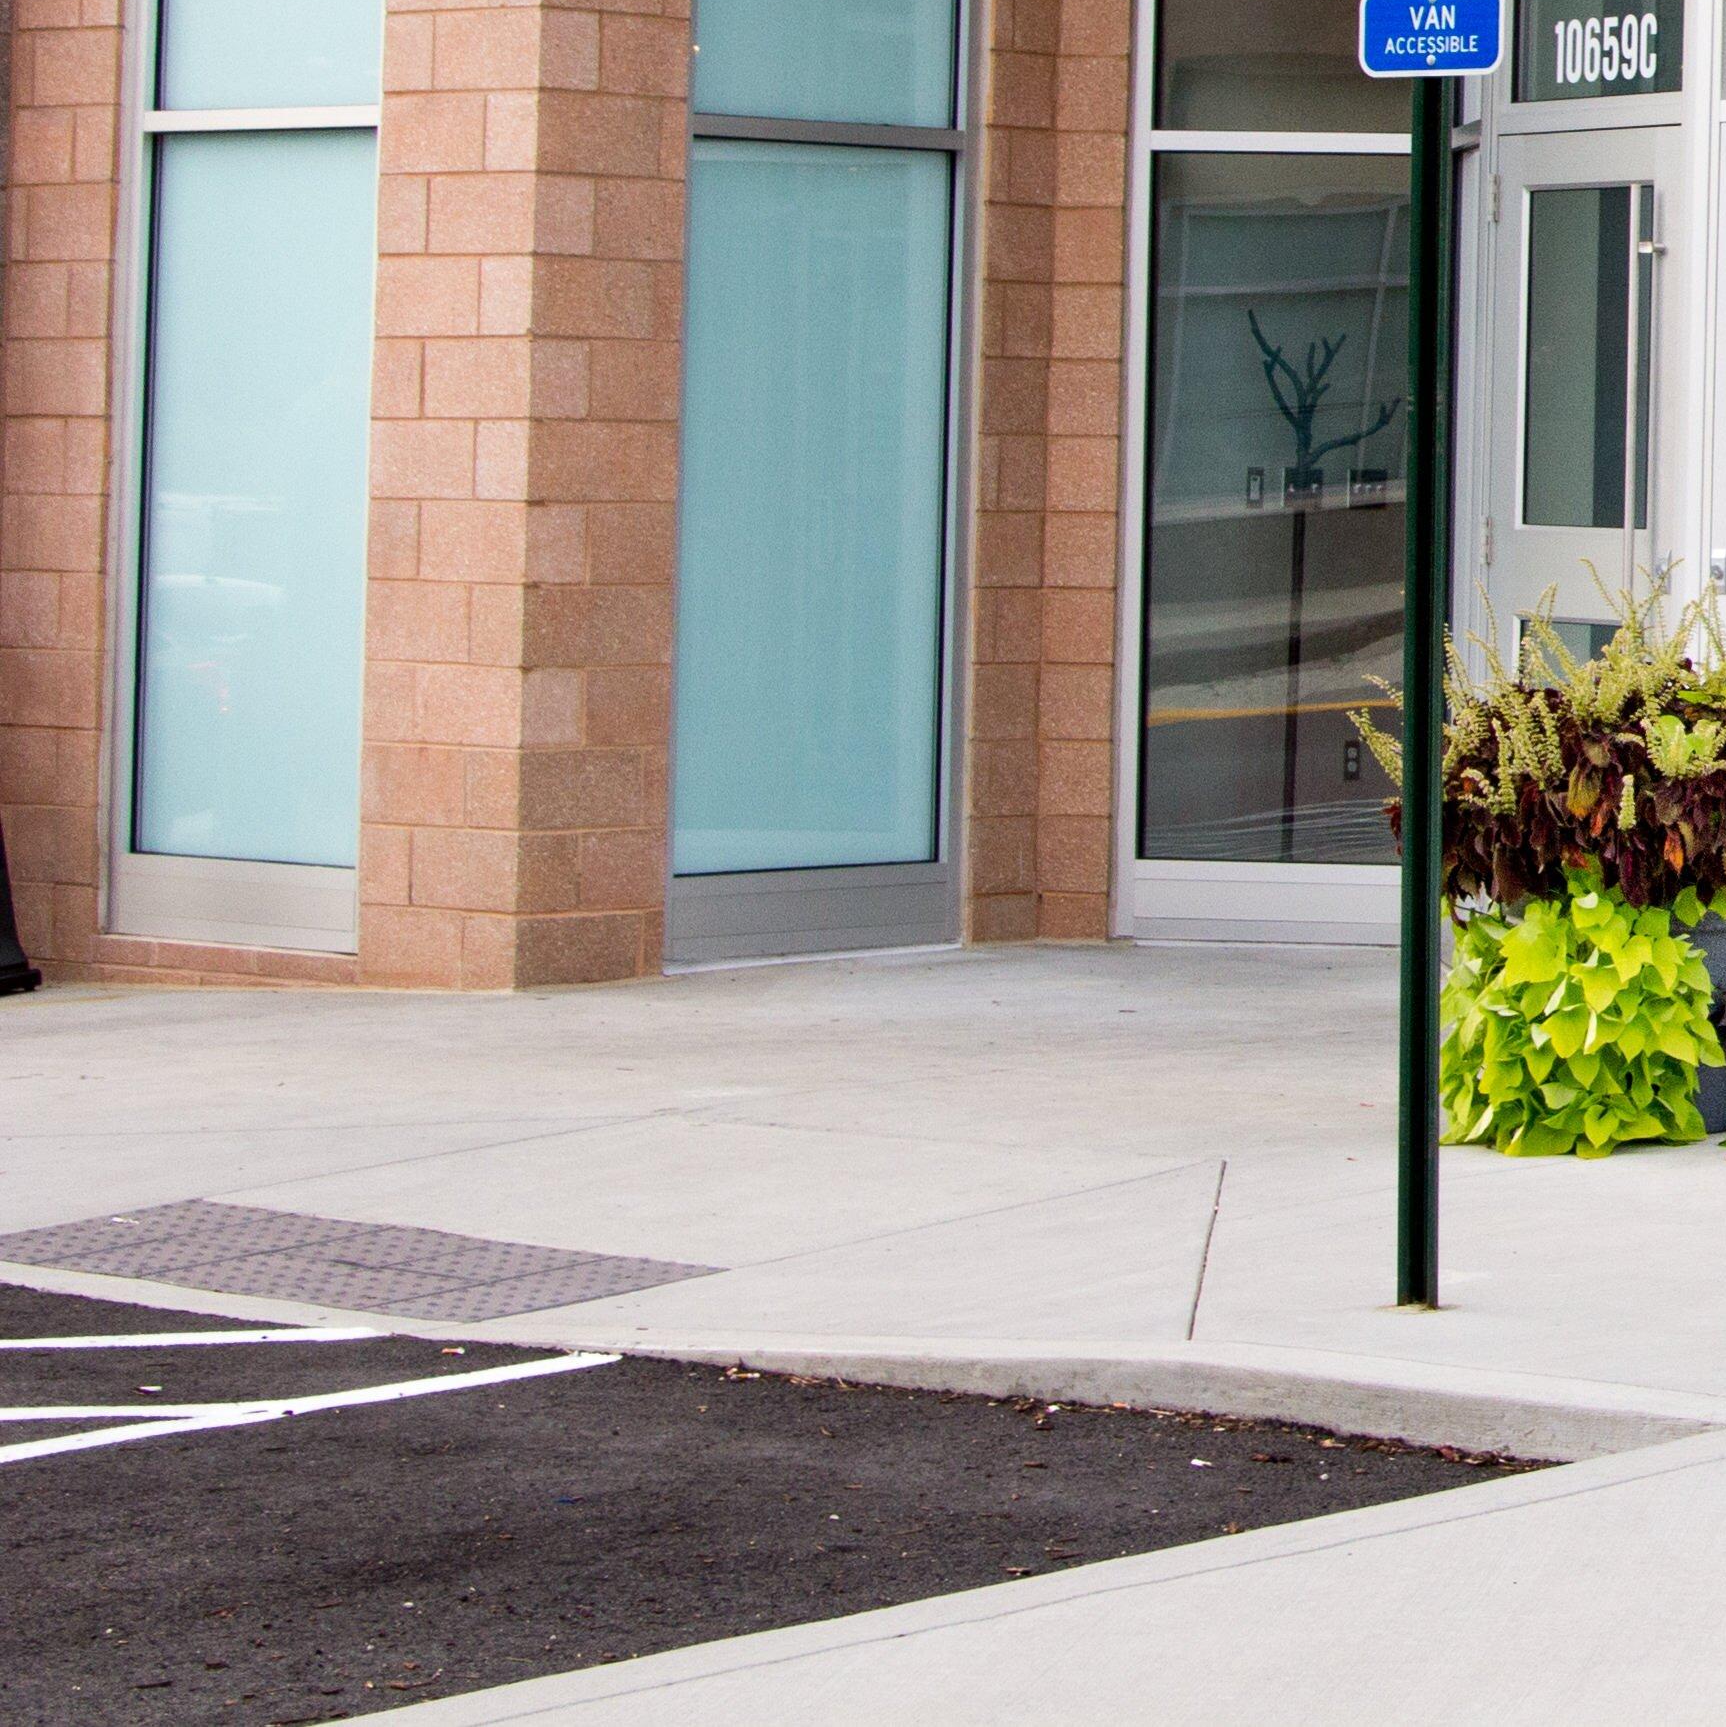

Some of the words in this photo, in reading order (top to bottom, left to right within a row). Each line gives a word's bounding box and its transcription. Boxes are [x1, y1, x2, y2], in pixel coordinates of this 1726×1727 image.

[1410, 5, 1456, 31] VAN
[1384, 35, 1478, 55] ACCESSIBLE
[1555, 12, 1658, 84] 10659C
